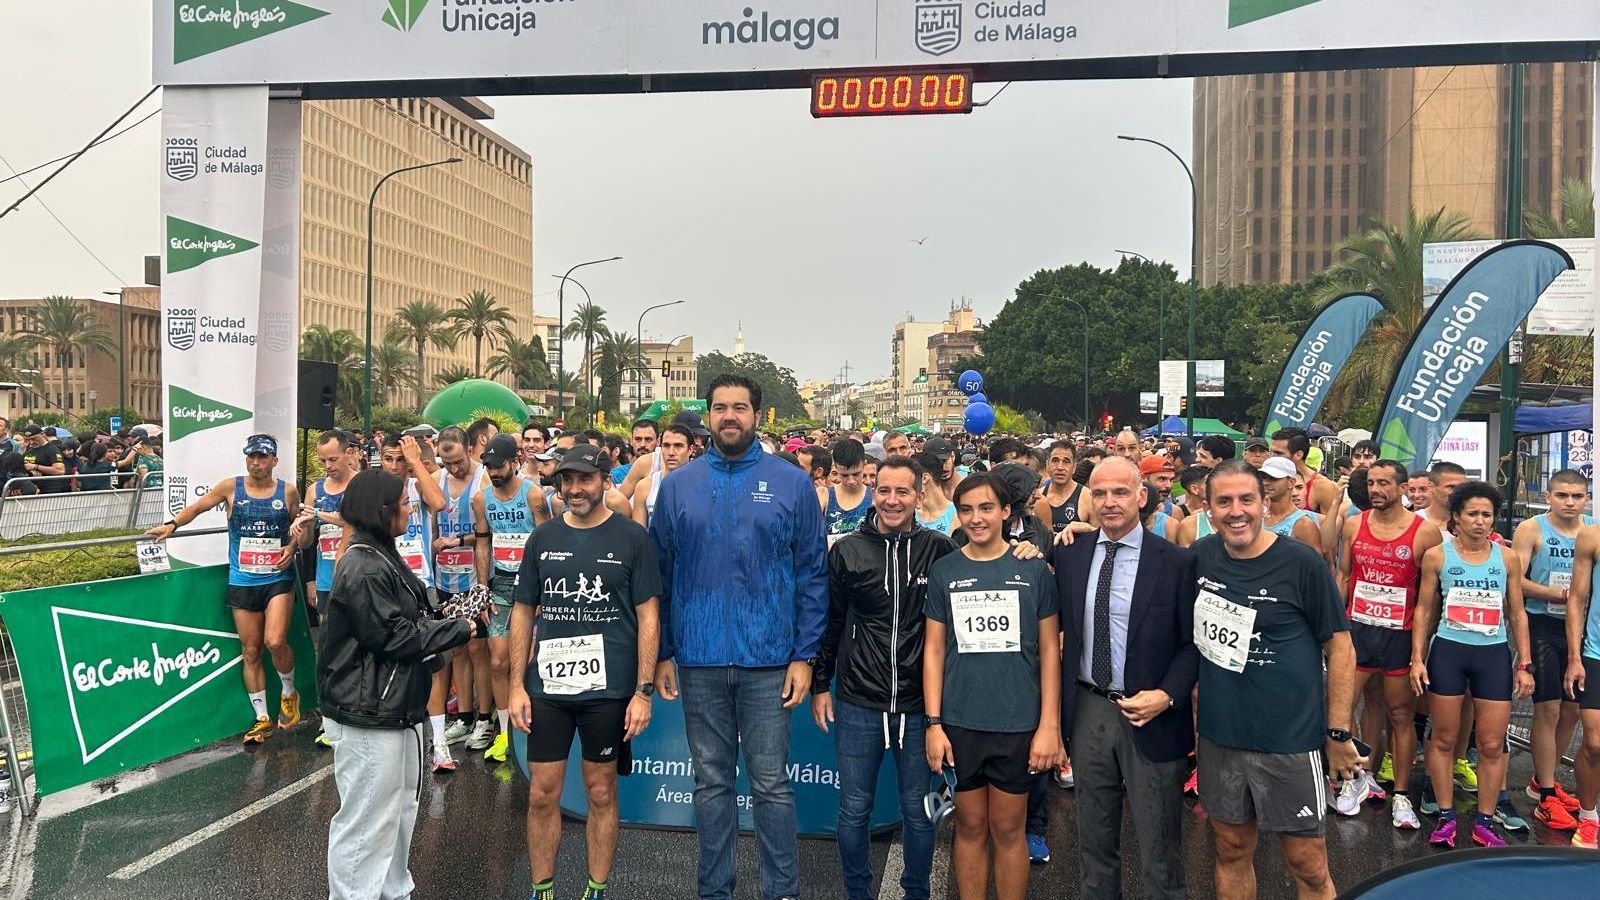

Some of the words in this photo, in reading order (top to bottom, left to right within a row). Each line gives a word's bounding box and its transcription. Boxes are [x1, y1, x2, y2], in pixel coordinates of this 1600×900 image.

[179, 5, 195, 22] El
[195, 5, 232, 22] Corte
[232, 0, 286, 29] Inglés
[974, 0, 1046, 19] Ciudad
[441, 6, 536, 36] Unicaja
[974, 26, 999, 42] de
[1005, 23, 1077, 43] Málaga
[205, 146, 247, 158] Ciudad
[204, 163, 217, 174] de
[221, 162, 263, 175] Málaga
[170, 238, 181, 249] El
[182, 239, 205, 249] Corte
[203, 235, 236, 252] Inglés
[199, 316, 245, 328] Ciudad
[199, 332, 214, 342] de
[218, 331, 257, 346] Málag
[1396, 289, 1489, 414] Fundación
[1274, 329, 1332, 416] Fundación
[1415, 335, 1489, 422] Unicaja
[1289, 360, 1334, 422] Unicaja
[172, 407, 182, 418] El
[196, 404, 233, 422] Inglés
[1571, 433, 1586, 442] 14
[1438, 442, 1460, 451] OTINA
[1462, 442, 1480, 452] EASY
[1571, 451, 1587, 462] 23
[1579, 468, 1593, 479] N2
[489, 506, 525, 522] nerja
[241, 524, 279, 532] MARBELLA
[250, 555, 272, 565] 182
[447, 555, 460, 564] 57
[508, 551, 516, 560] 4
[1362, 565, 1394, 584] Vélez
[1454, 577, 1500, 590] nerja
[1366, 601, 1392, 618] 203
[1466, 610, 1484, 621] 11
[965, 616, 1010, 632] 1369
[1202, 620, 1239, 649] 1362
[72, 662, 99, 691] El
[98, 658, 151, 686] Corte
[151, 641, 220, 686] Inglés
[545, 658, 600, 679] 12730
[631, 758, 695, 777] ntami
[785, 763, 840, 789] Málag
[656, 784, 693, 804] Área
